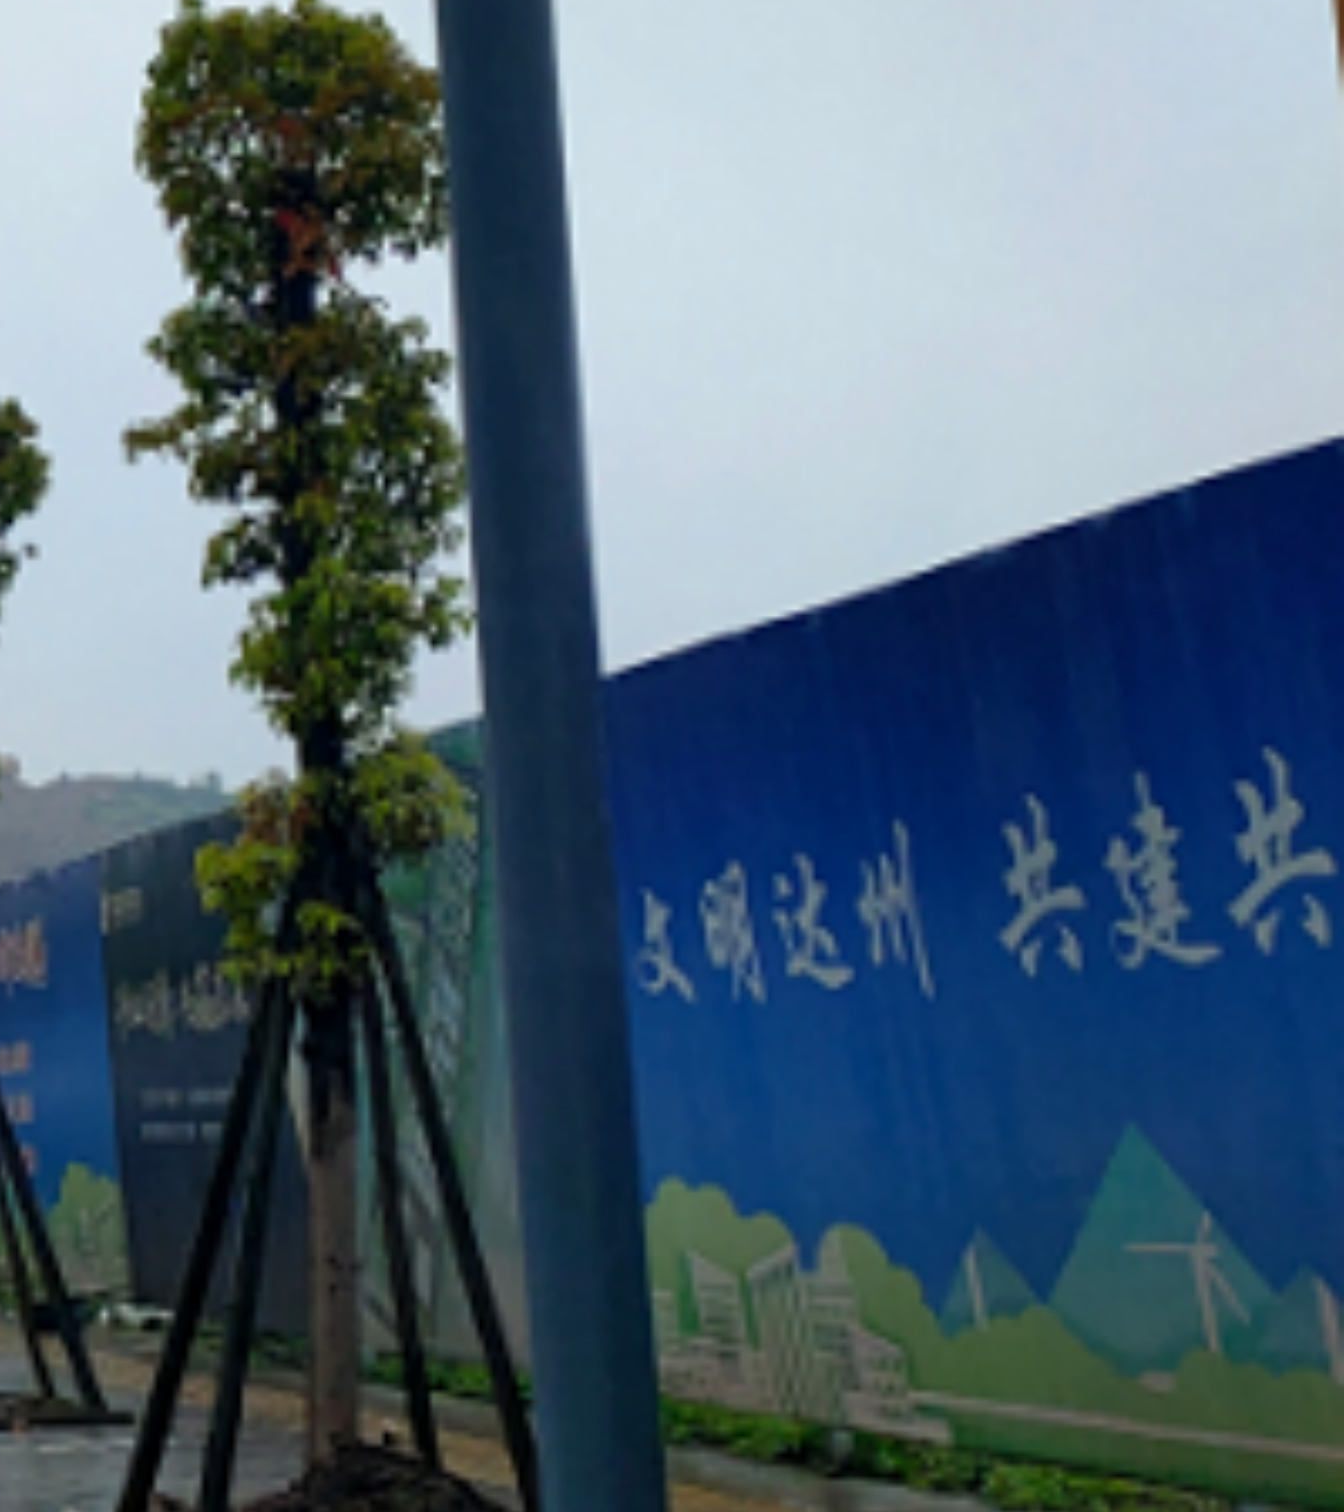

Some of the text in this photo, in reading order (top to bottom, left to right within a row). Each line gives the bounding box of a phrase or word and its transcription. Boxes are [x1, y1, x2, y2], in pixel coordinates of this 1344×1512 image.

[635, 745, 1339, 1003] 文明达州 共建共
